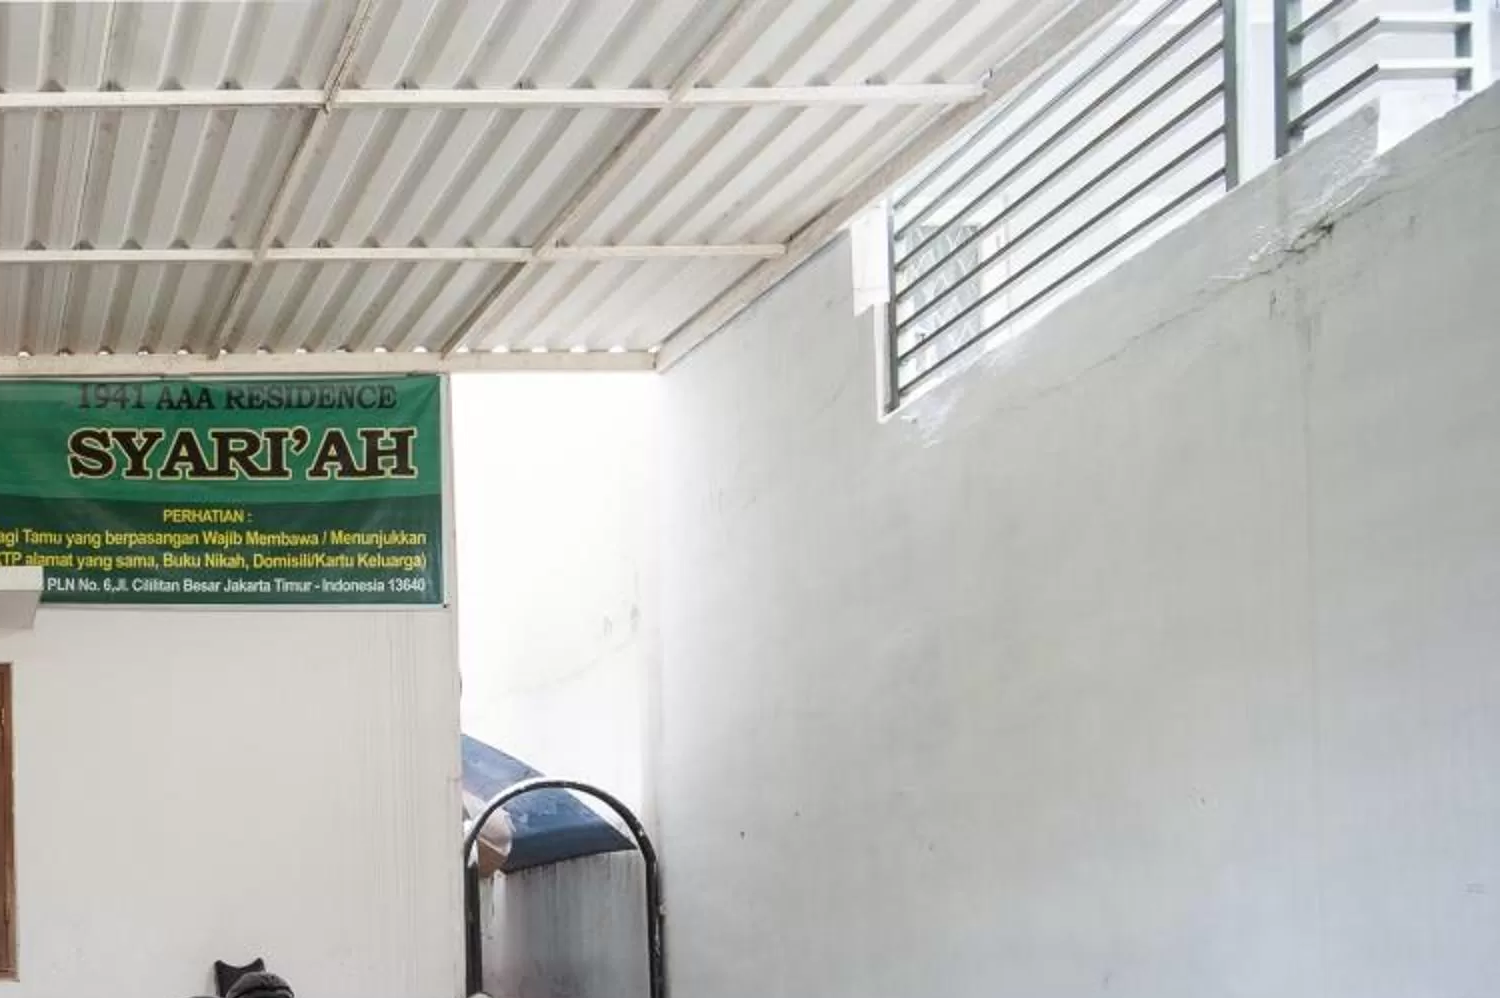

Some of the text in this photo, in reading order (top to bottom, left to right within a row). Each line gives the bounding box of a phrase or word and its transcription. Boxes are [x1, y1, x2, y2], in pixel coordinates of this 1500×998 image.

[79, 384, 398, 410] 1941 AAA RESIDENCE
[68, 426, 418, 480] SYARI'AH
[163, 509, 244, 523] PERHATIAN
[23, 529, 62, 544] Tamu
[65, 533, 101, 548] yang
[105, 530, 199, 548] berpasangan
[202, 530, 242, 548] Wajib
[246, 530, 319, 545] Membawa
[330, 530, 428, 549] Menunjukkan
[25, 552, 73, 567] alamat
[76, 556, 113, 571] yang
[163, 552, 201, 567] Buku
[205, 552, 249, 571] Nikah,
[357, 552, 427, 571] Keluarga)
[47, 577, 75, 591] PLN
[78, 577, 100, 591] No.
[183, 577, 220, 592] Besar
[224, 577, 271, 592] Jakarta
[274, 577, 312, 592] Timur
[322, 577, 384, 592] Indonesia
[388, 576, 426, 592] 13640
